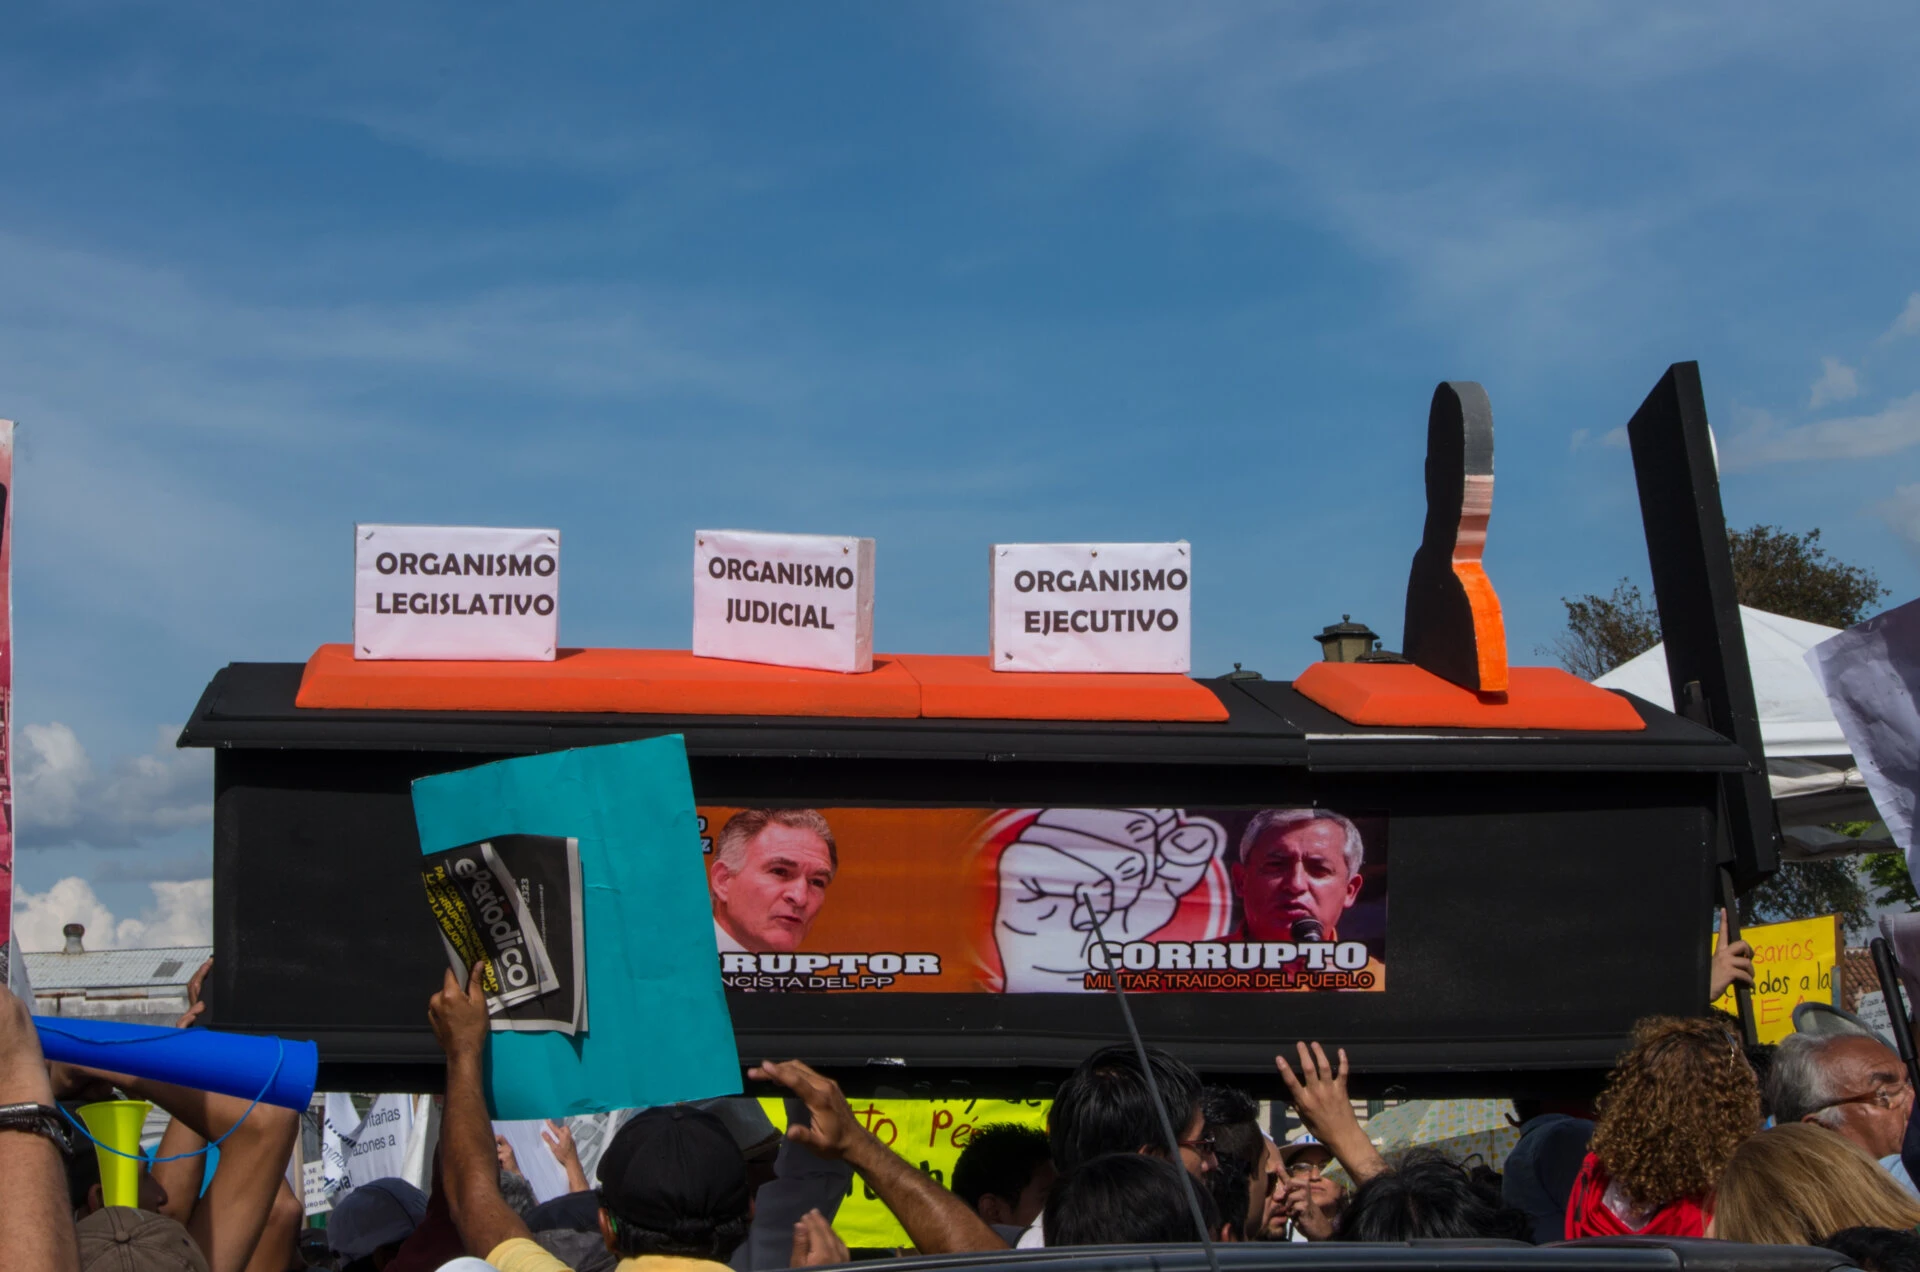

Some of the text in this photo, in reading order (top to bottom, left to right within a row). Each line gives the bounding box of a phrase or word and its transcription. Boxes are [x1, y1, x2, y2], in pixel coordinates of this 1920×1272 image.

[376, 552, 556, 577] ORGANISMO
[708, 556, 854, 590] ORGANISMO
[1014, 568, 1188, 593] ORGANISMO
[376, 592, 555, 616] LEGISLATIVO
[726, 598, 835, 630] JUDICIAL
[1024, 608, 1179, 636] EJECUTIVO
[721, 953, 941, 974] RUPTOR
[1089, 941, 1368, 970] CORRUPTO
[1753, 938, 1814, 964] sarios
[721, 976, 893, 988] NCISTA DEL PP
[1163, 973, 1250, 988] TRAIDOR
[1255, 973, 1293, 988] DEL
[1297, 973, 1374, 988] PUEBLO
[1800, 975, 1810, 991] a
[1816, 961, 1833, 990] la
[366, 1108, 401, 1129] ntañas
[352, 1133, 397, 1157] azones a
